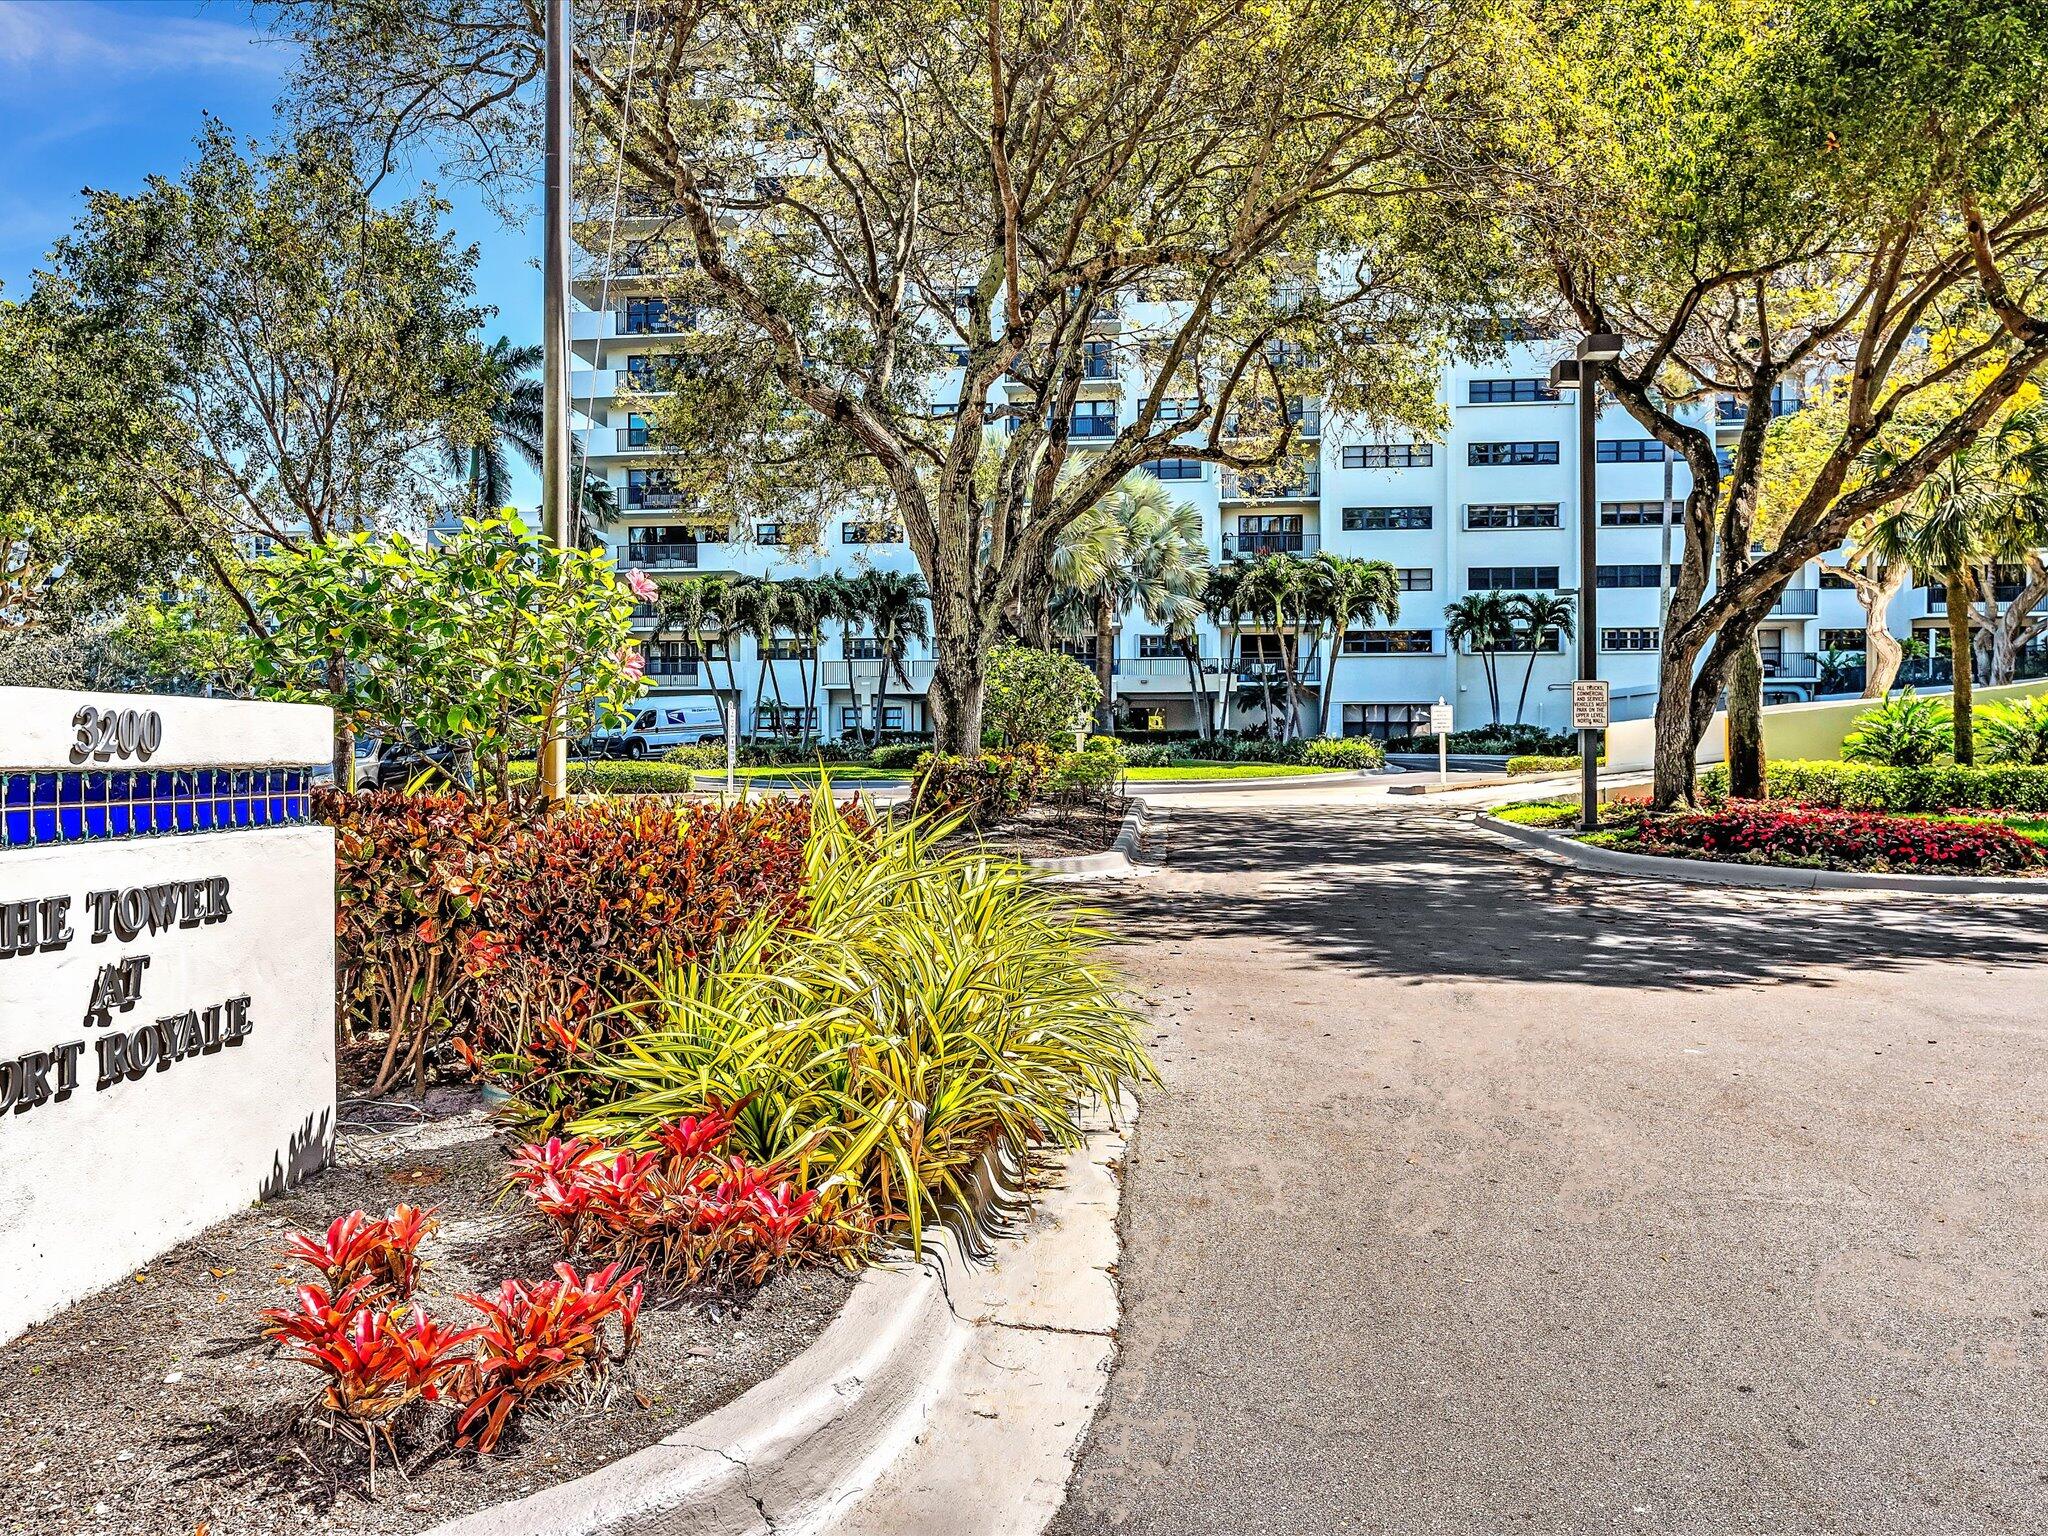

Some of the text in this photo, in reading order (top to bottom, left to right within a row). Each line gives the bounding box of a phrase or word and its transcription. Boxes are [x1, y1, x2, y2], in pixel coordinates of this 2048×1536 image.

[72, 704, 162, 756] 3200
[0, 875, 233, 951] HE TOWER
[91, 955, 151, 1013] AT
[0, 993, 254, 1110] ORT ROYALE
